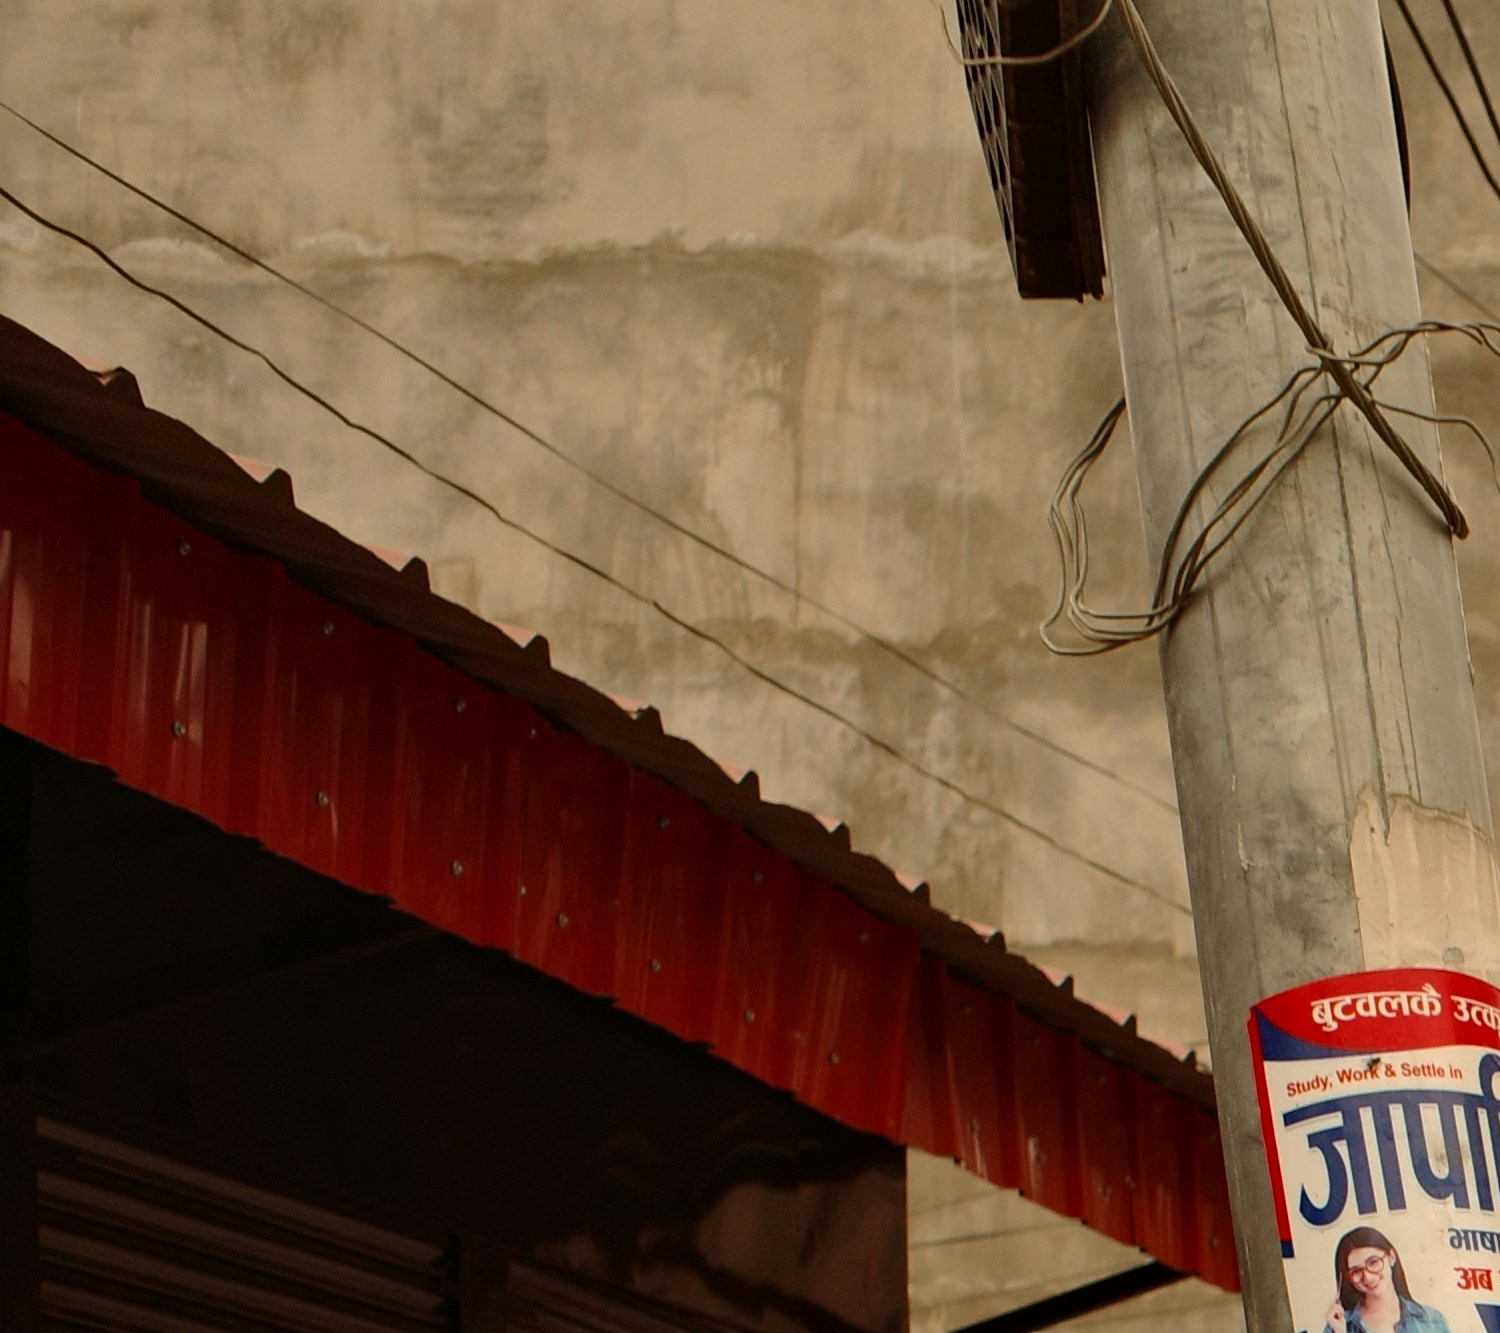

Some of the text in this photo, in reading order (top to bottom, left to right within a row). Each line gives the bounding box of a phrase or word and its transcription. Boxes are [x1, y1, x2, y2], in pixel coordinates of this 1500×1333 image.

[1310, 983, 1442, 1032] बुटवलकै
[1286, 1062, 1463, 1098] Study, Work & Settle in
[1454, 1266, 1494, 1291] अब
